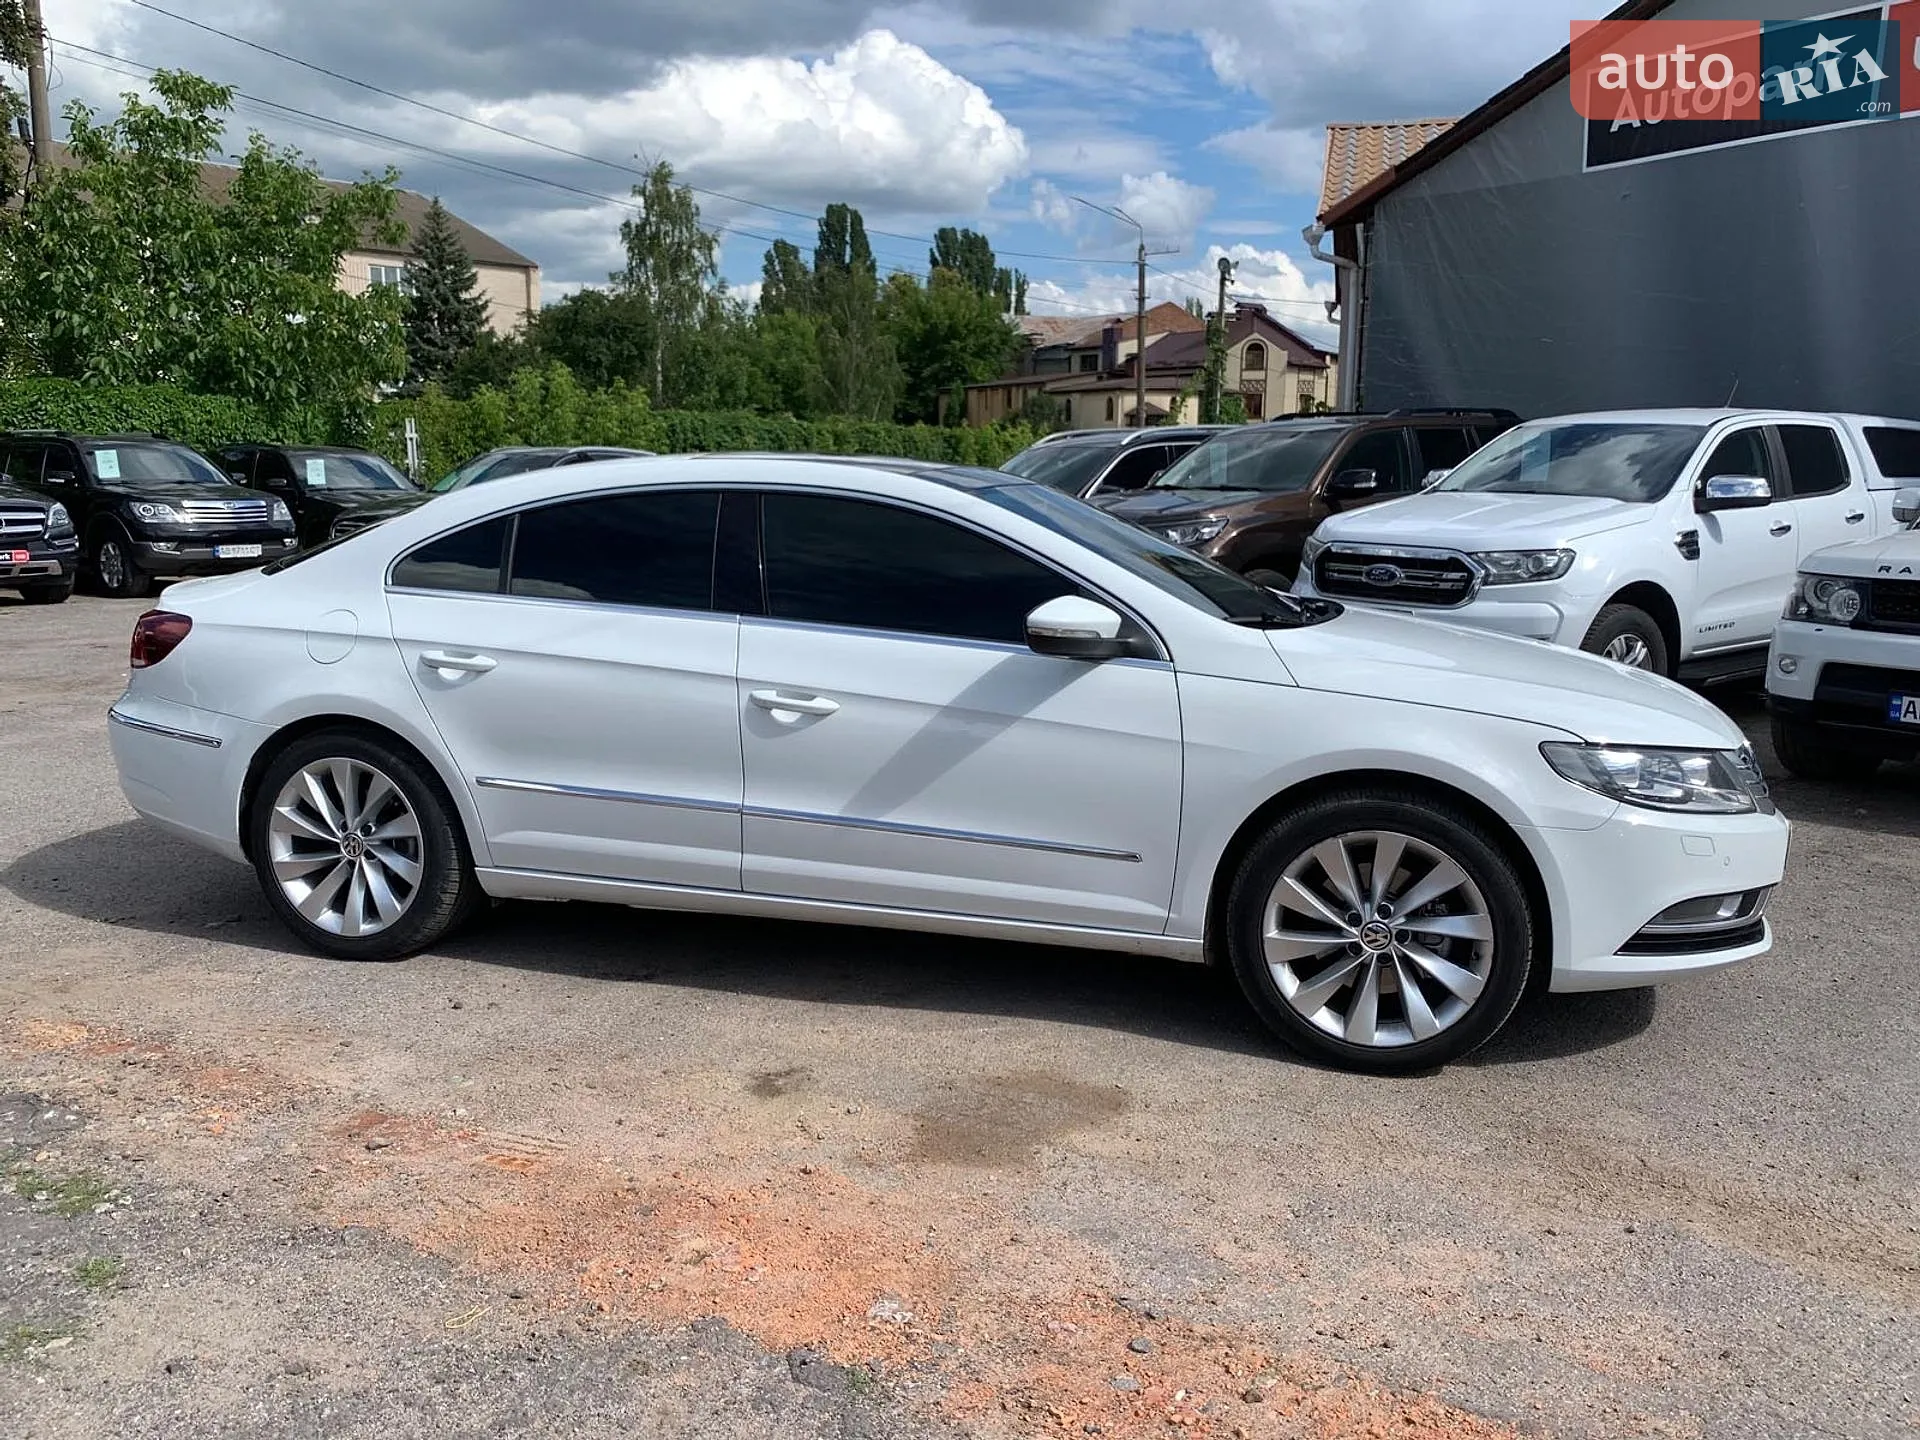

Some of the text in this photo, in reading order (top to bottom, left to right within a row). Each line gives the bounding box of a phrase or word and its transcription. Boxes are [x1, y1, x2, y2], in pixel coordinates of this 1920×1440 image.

[1877, 565, 1913, 575] RA
[1699, 621, 1735, 633] LIMITED
[1902, 699, 1920, 720] A
